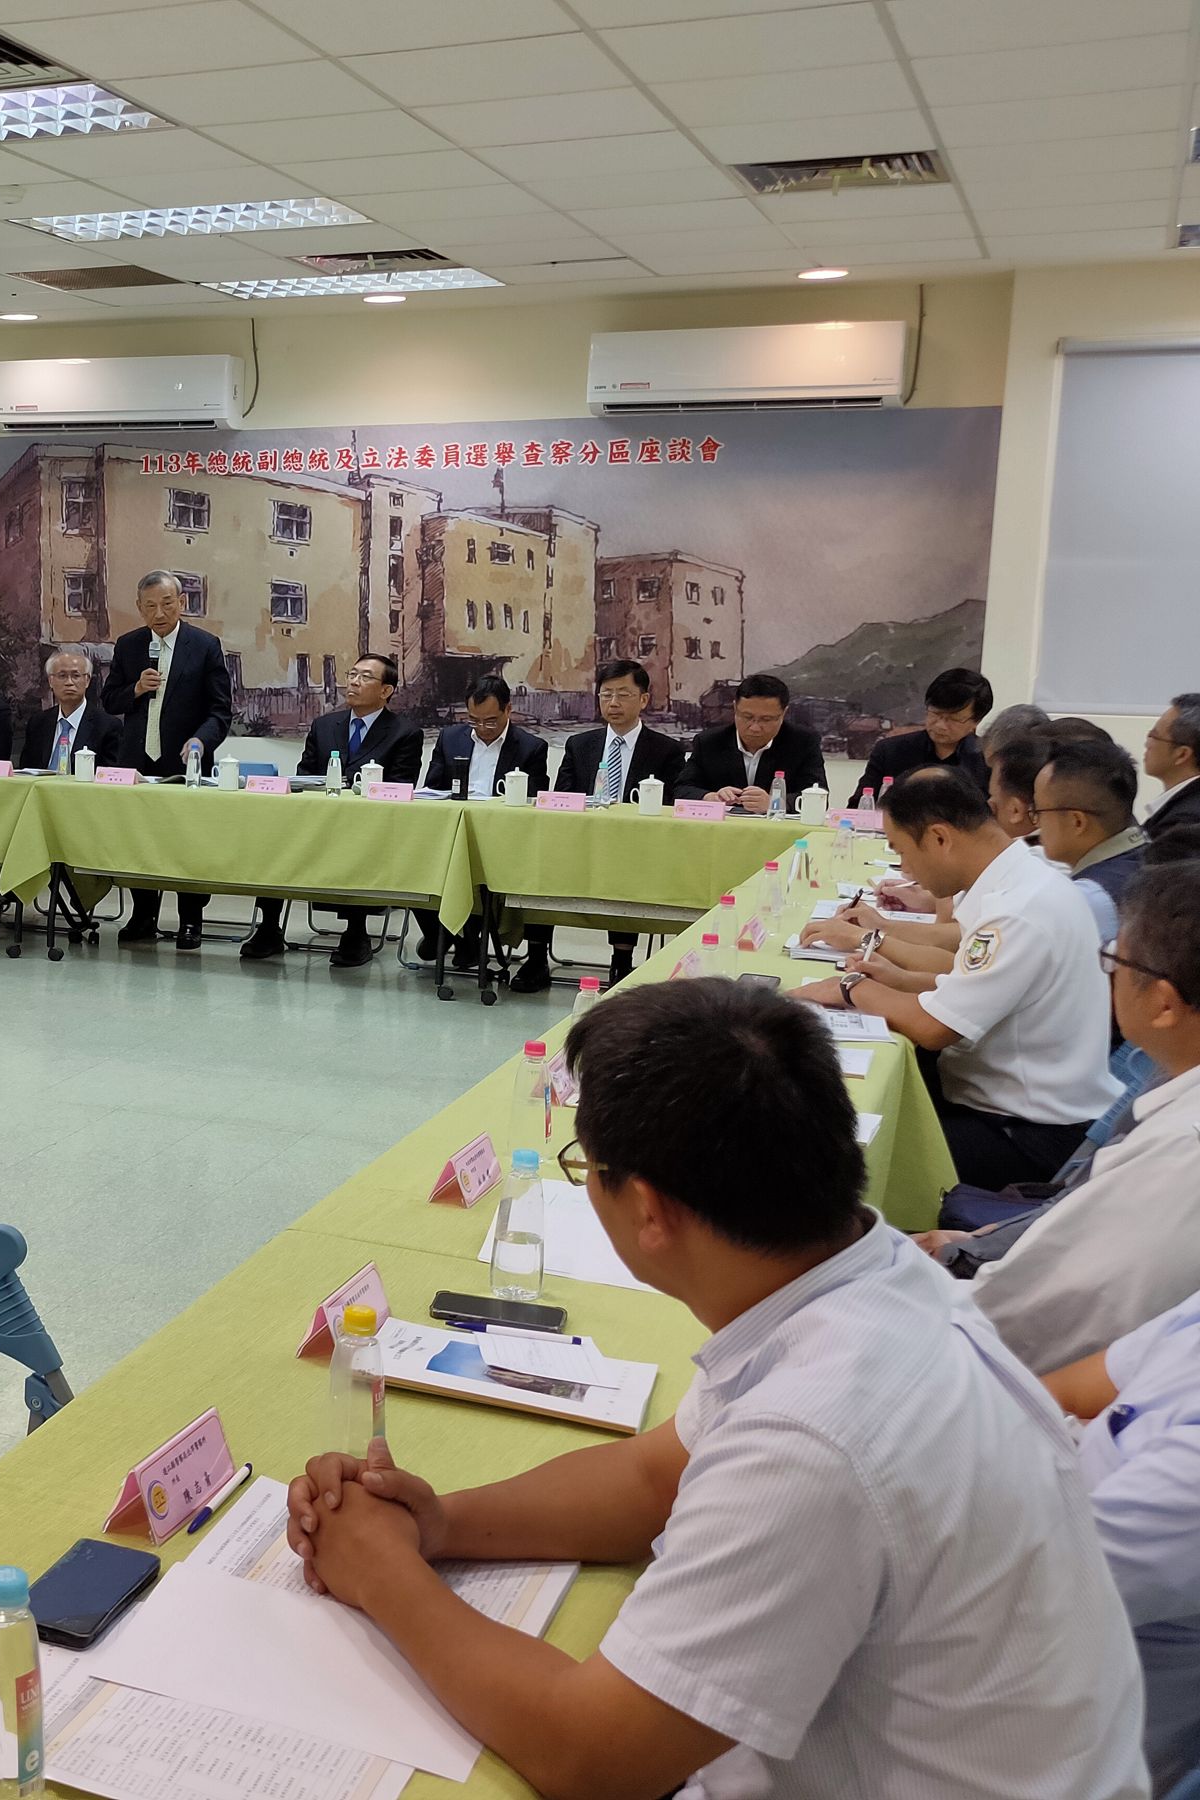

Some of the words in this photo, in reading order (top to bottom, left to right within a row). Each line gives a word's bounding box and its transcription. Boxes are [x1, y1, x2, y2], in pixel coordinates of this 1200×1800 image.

[140, 436, 724, 475] 113年總統副總統及立法委員選舉查察分區座談會
